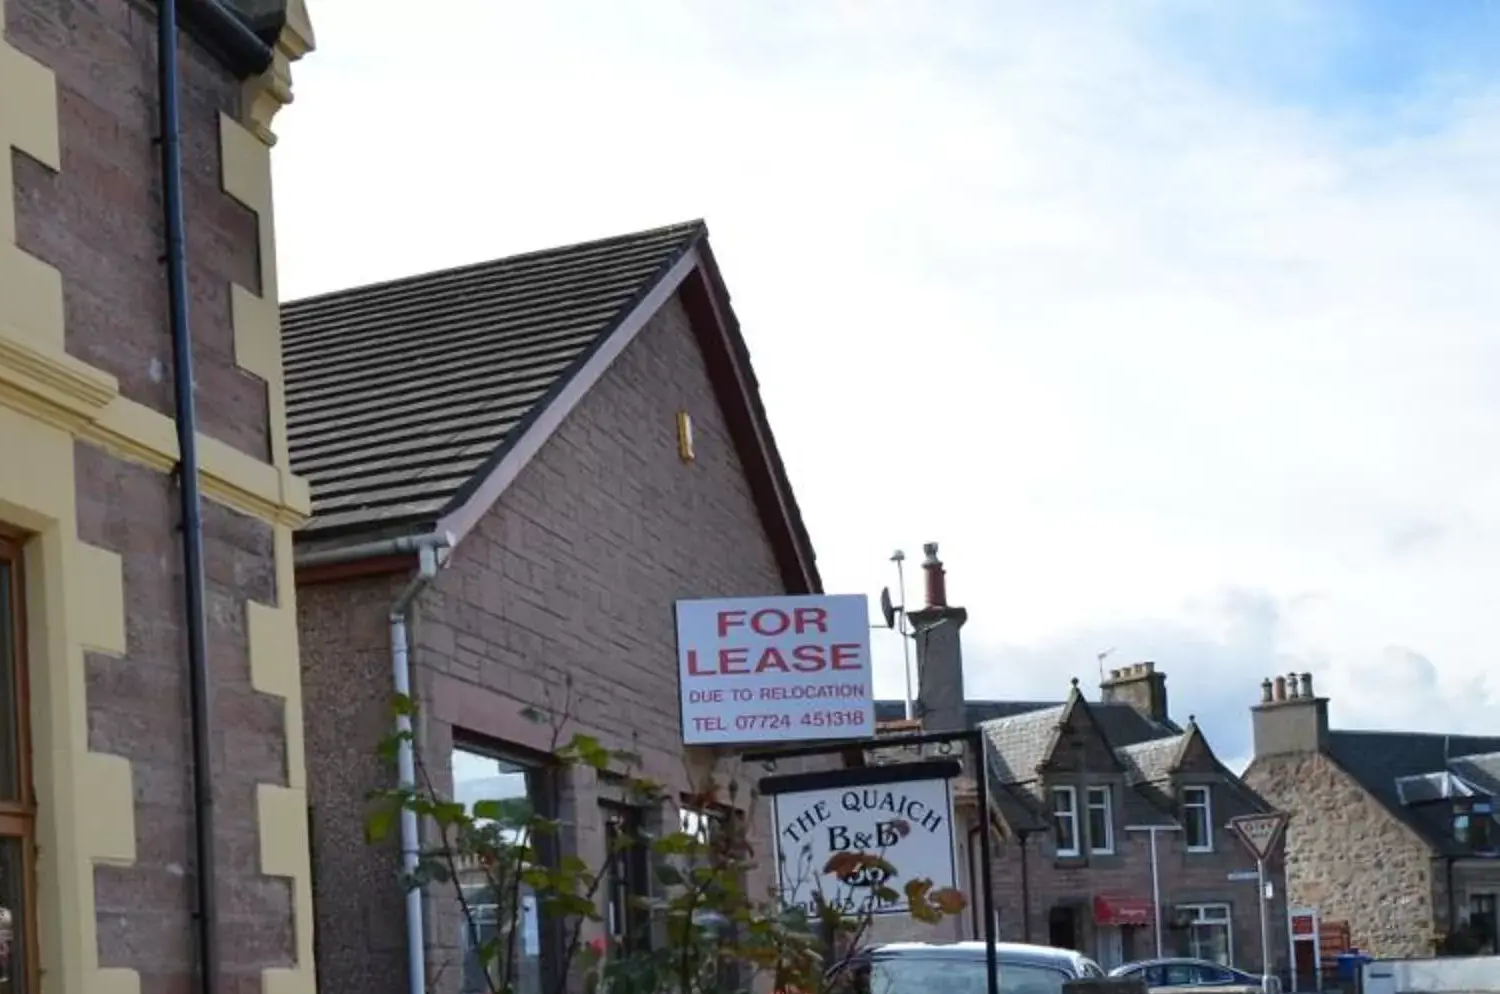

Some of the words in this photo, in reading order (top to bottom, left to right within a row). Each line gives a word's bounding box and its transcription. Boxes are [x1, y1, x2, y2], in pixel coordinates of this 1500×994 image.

[717, 607, 828, 638] FOR
[687, 643, 863, 676] LEASE
[689, 689, 724, 704] DUE
[732, 687, 753, 702] TO
[759, 683, 865, 701] RELOCATION
[692, 716, 725, 732] TEL
[735, 714, 791, 731] 07724
[801, 710, 864, 728] 451318
[782, 800, 832, 843] THE
[841, 789, 942, 833] QUAICH
[827, 821, 899, 852] B&B
